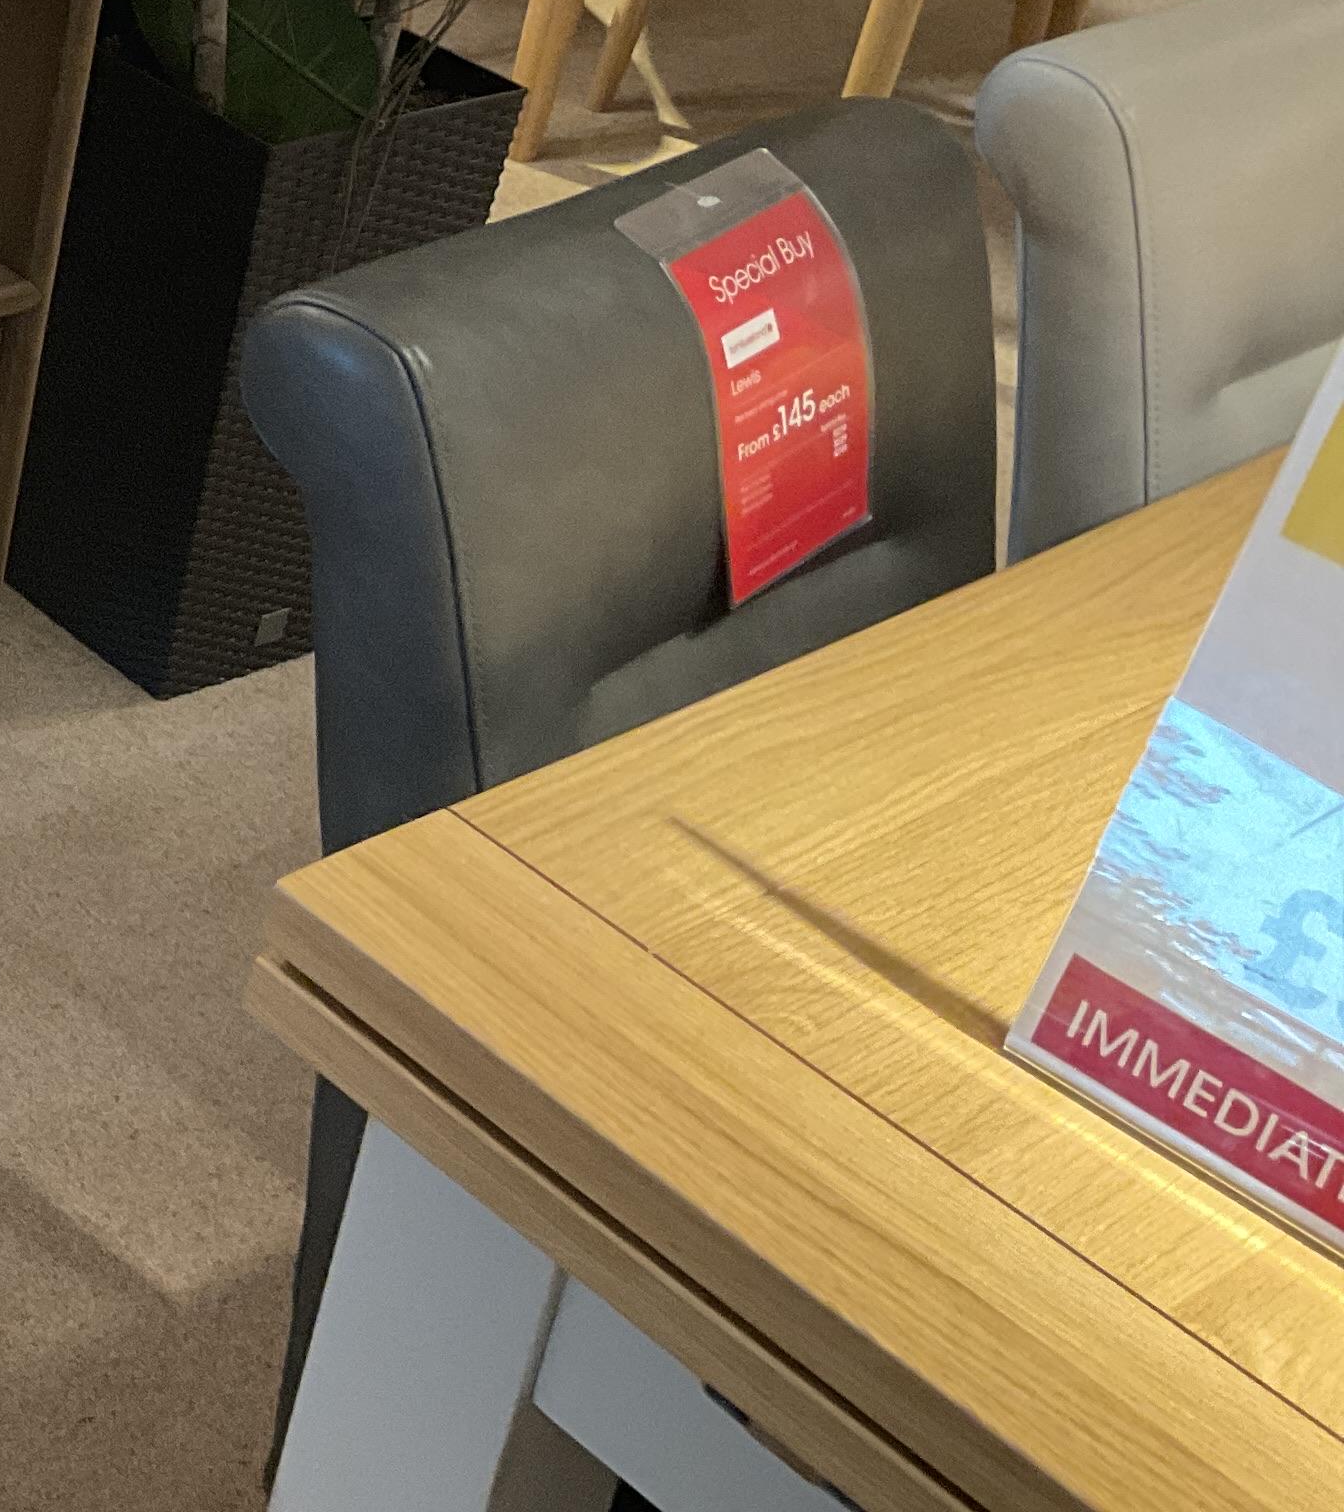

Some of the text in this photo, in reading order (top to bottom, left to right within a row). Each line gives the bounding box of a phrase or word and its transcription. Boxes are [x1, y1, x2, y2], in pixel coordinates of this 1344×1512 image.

[709, 230, 815, 305] Special Buy
[730, 368, 762, 397] Lewis
[738, 431, 771, 462] From
[772, 388, 816, 442] £145
[818, 384, 851, 414] each
[1067, 998, 1344, 1204] IMMEDIAT
